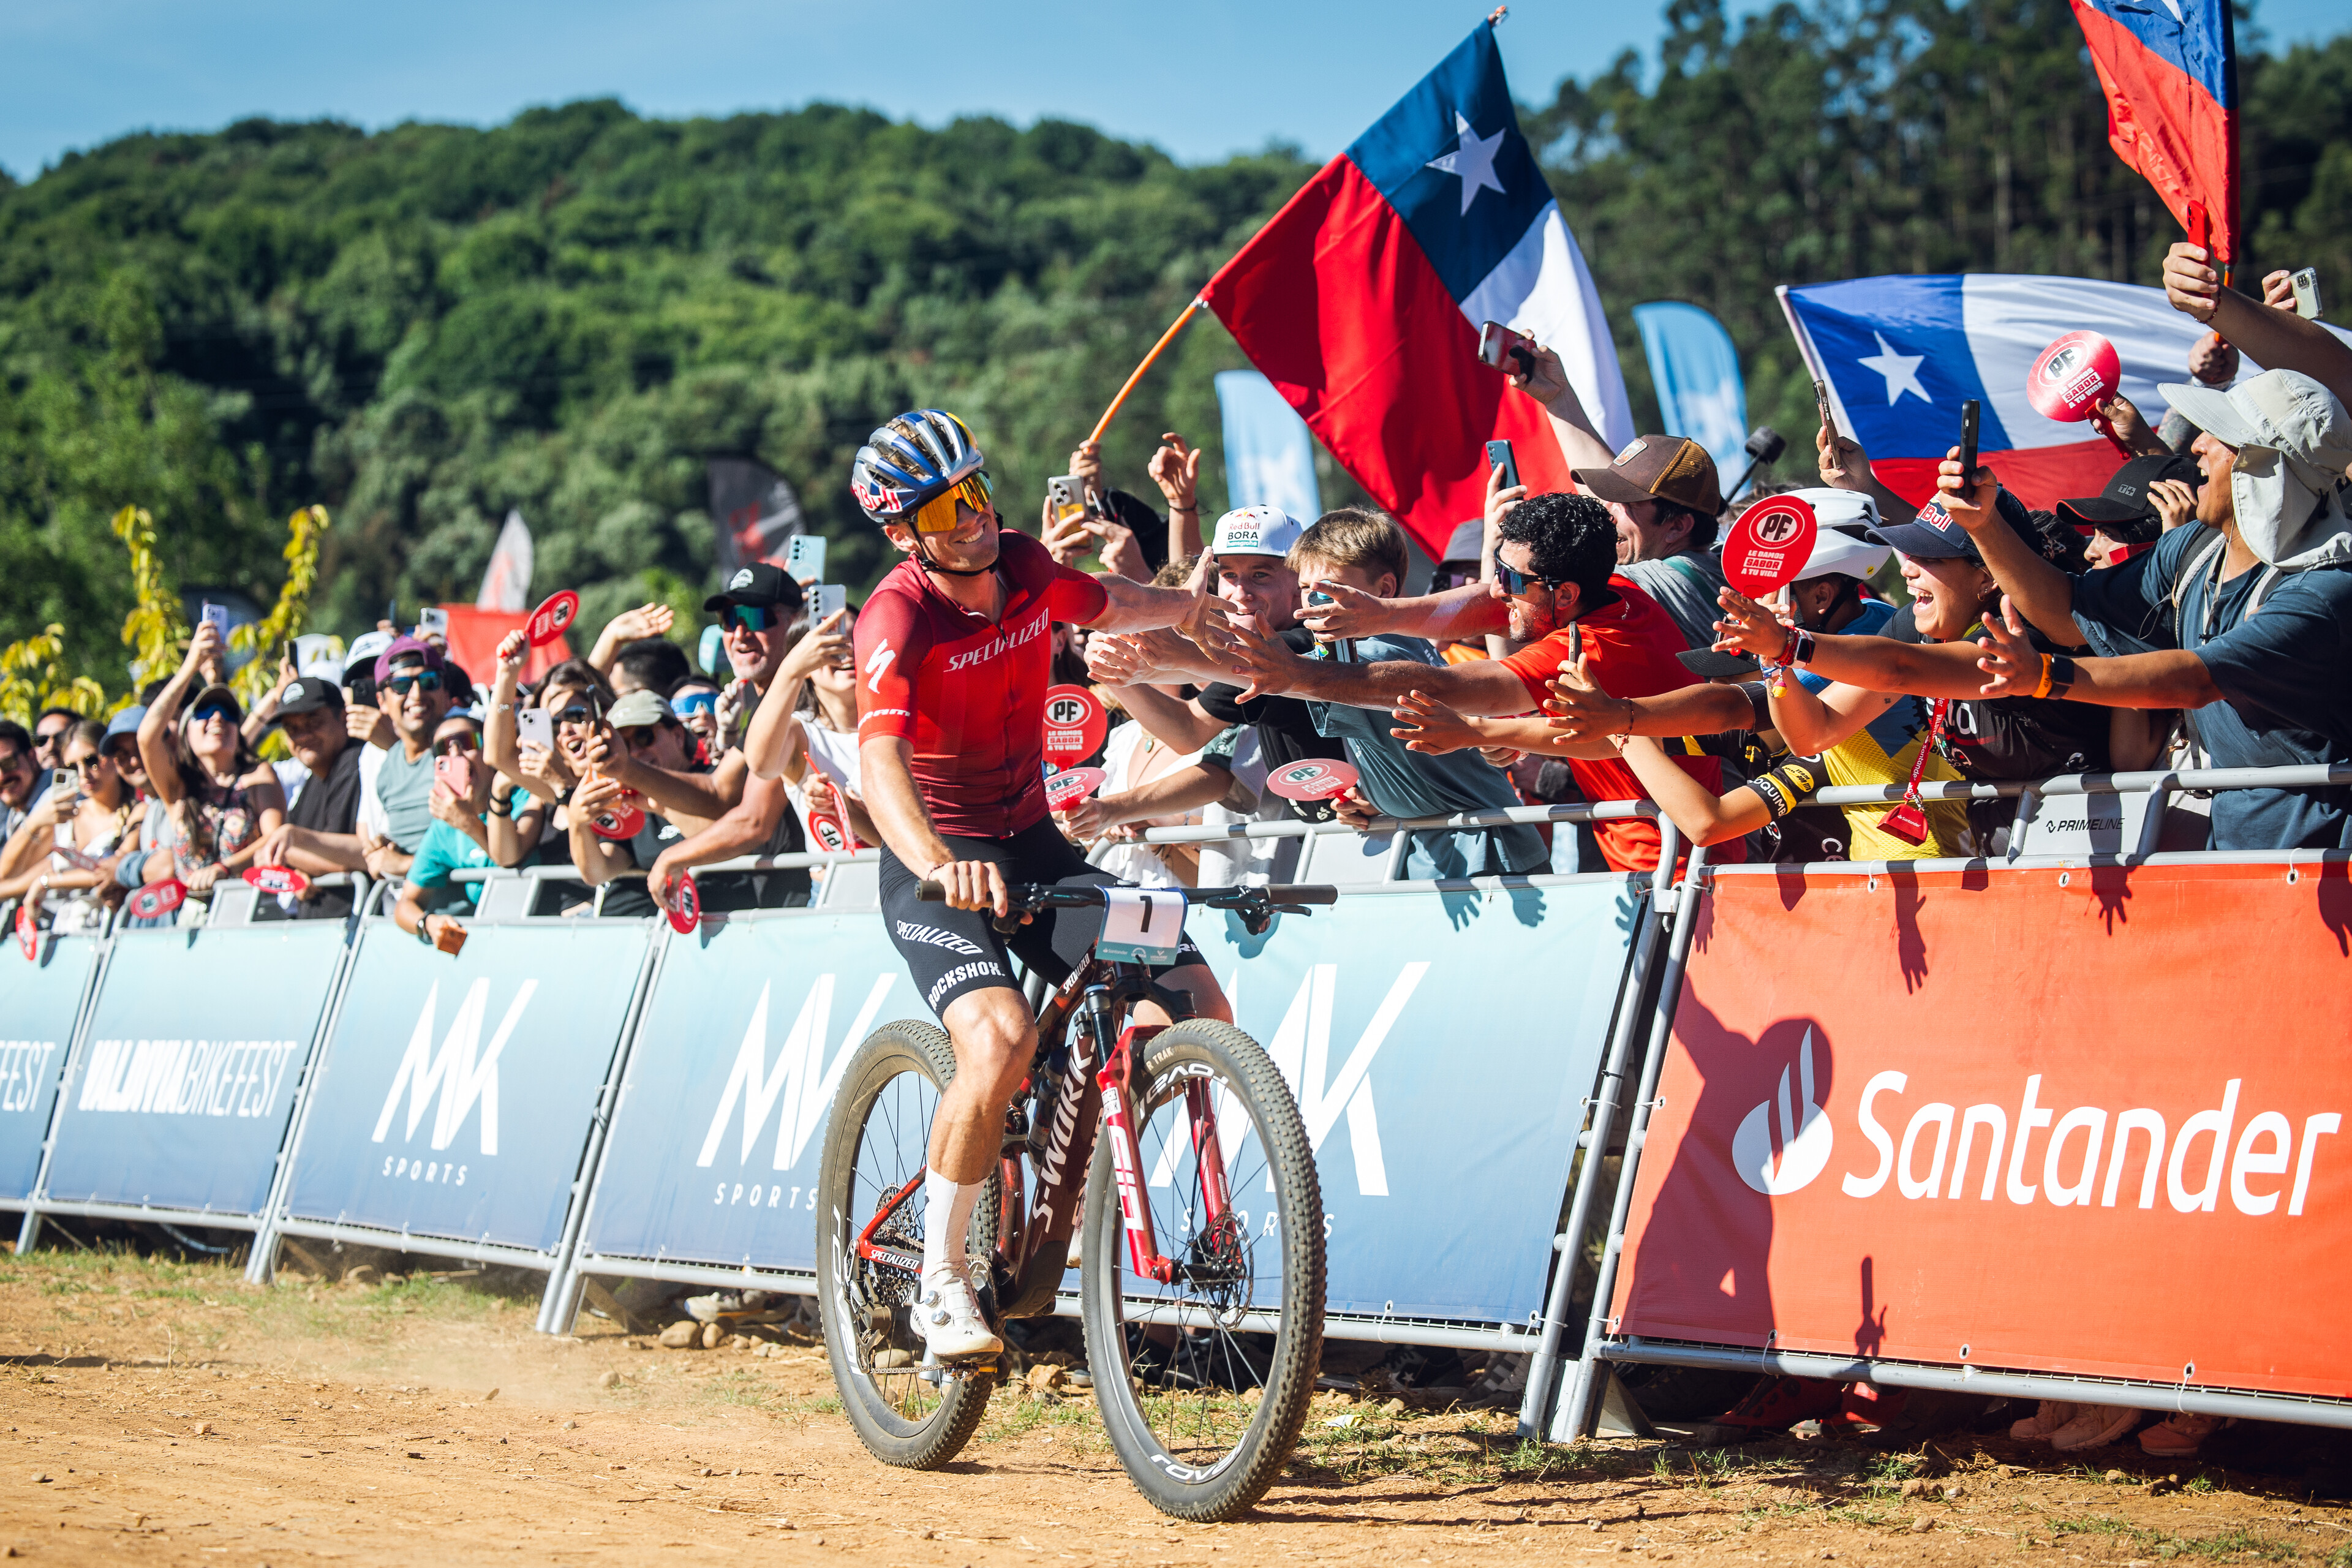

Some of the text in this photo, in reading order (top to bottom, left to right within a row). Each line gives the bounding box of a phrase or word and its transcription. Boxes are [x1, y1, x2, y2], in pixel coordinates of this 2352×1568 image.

[2049, 349, 2075, 378] PF
[2065, 375, 2098, 401] SABOR
[2073, 393, 2086, 404] TU
[2084, 381, 2105, 396] VIDA
[1761, 514, 1793, 541] PF
[1921, 505, 1952, 531] Bull
[1227, 531, 1258, 540] BORA
[1746, 558, 1780, 569] SABOR
[1758, 551, 1785, 559] DAMOS
[943, 607, 1049, 673] SPECIALIZED
[1054, 701, 1078, 721] PF
[1289, 767, 1316, 781] PF
[1796, 769, 1810, 780] TEAM
[1912, 744, 1928, 782] Santander
[1050, 777, 1074, 791] PF
[821, 827, 841, 846] PF
[2057, 818, 2125, 831] PRIMELINE
[1139, 895, 1153, 933] 1
[897, 919, 984, 956] SPECIALIZED
[1063, 953, 1090, 995] SPECIALIZED
[372, 977, 539, 1156] MK
[1152, 1046, 1174, 1065] TRAK
[78, 1039, 298, 1118] VALDIVIABIKEFEST
[1139, 1063, 1229, 1120] roval
[1841, 1070, 2342, 1216] Santander
[382, 1155, 468, 1186] SPORTS
[1109, 1125, 1144, 1231] SID
[714, 1182, 818, 1211] SPORTS
[1180, 1207, 1335, 1238] SORS
[869, 1249, 920, 1270] SPECIALIZED
